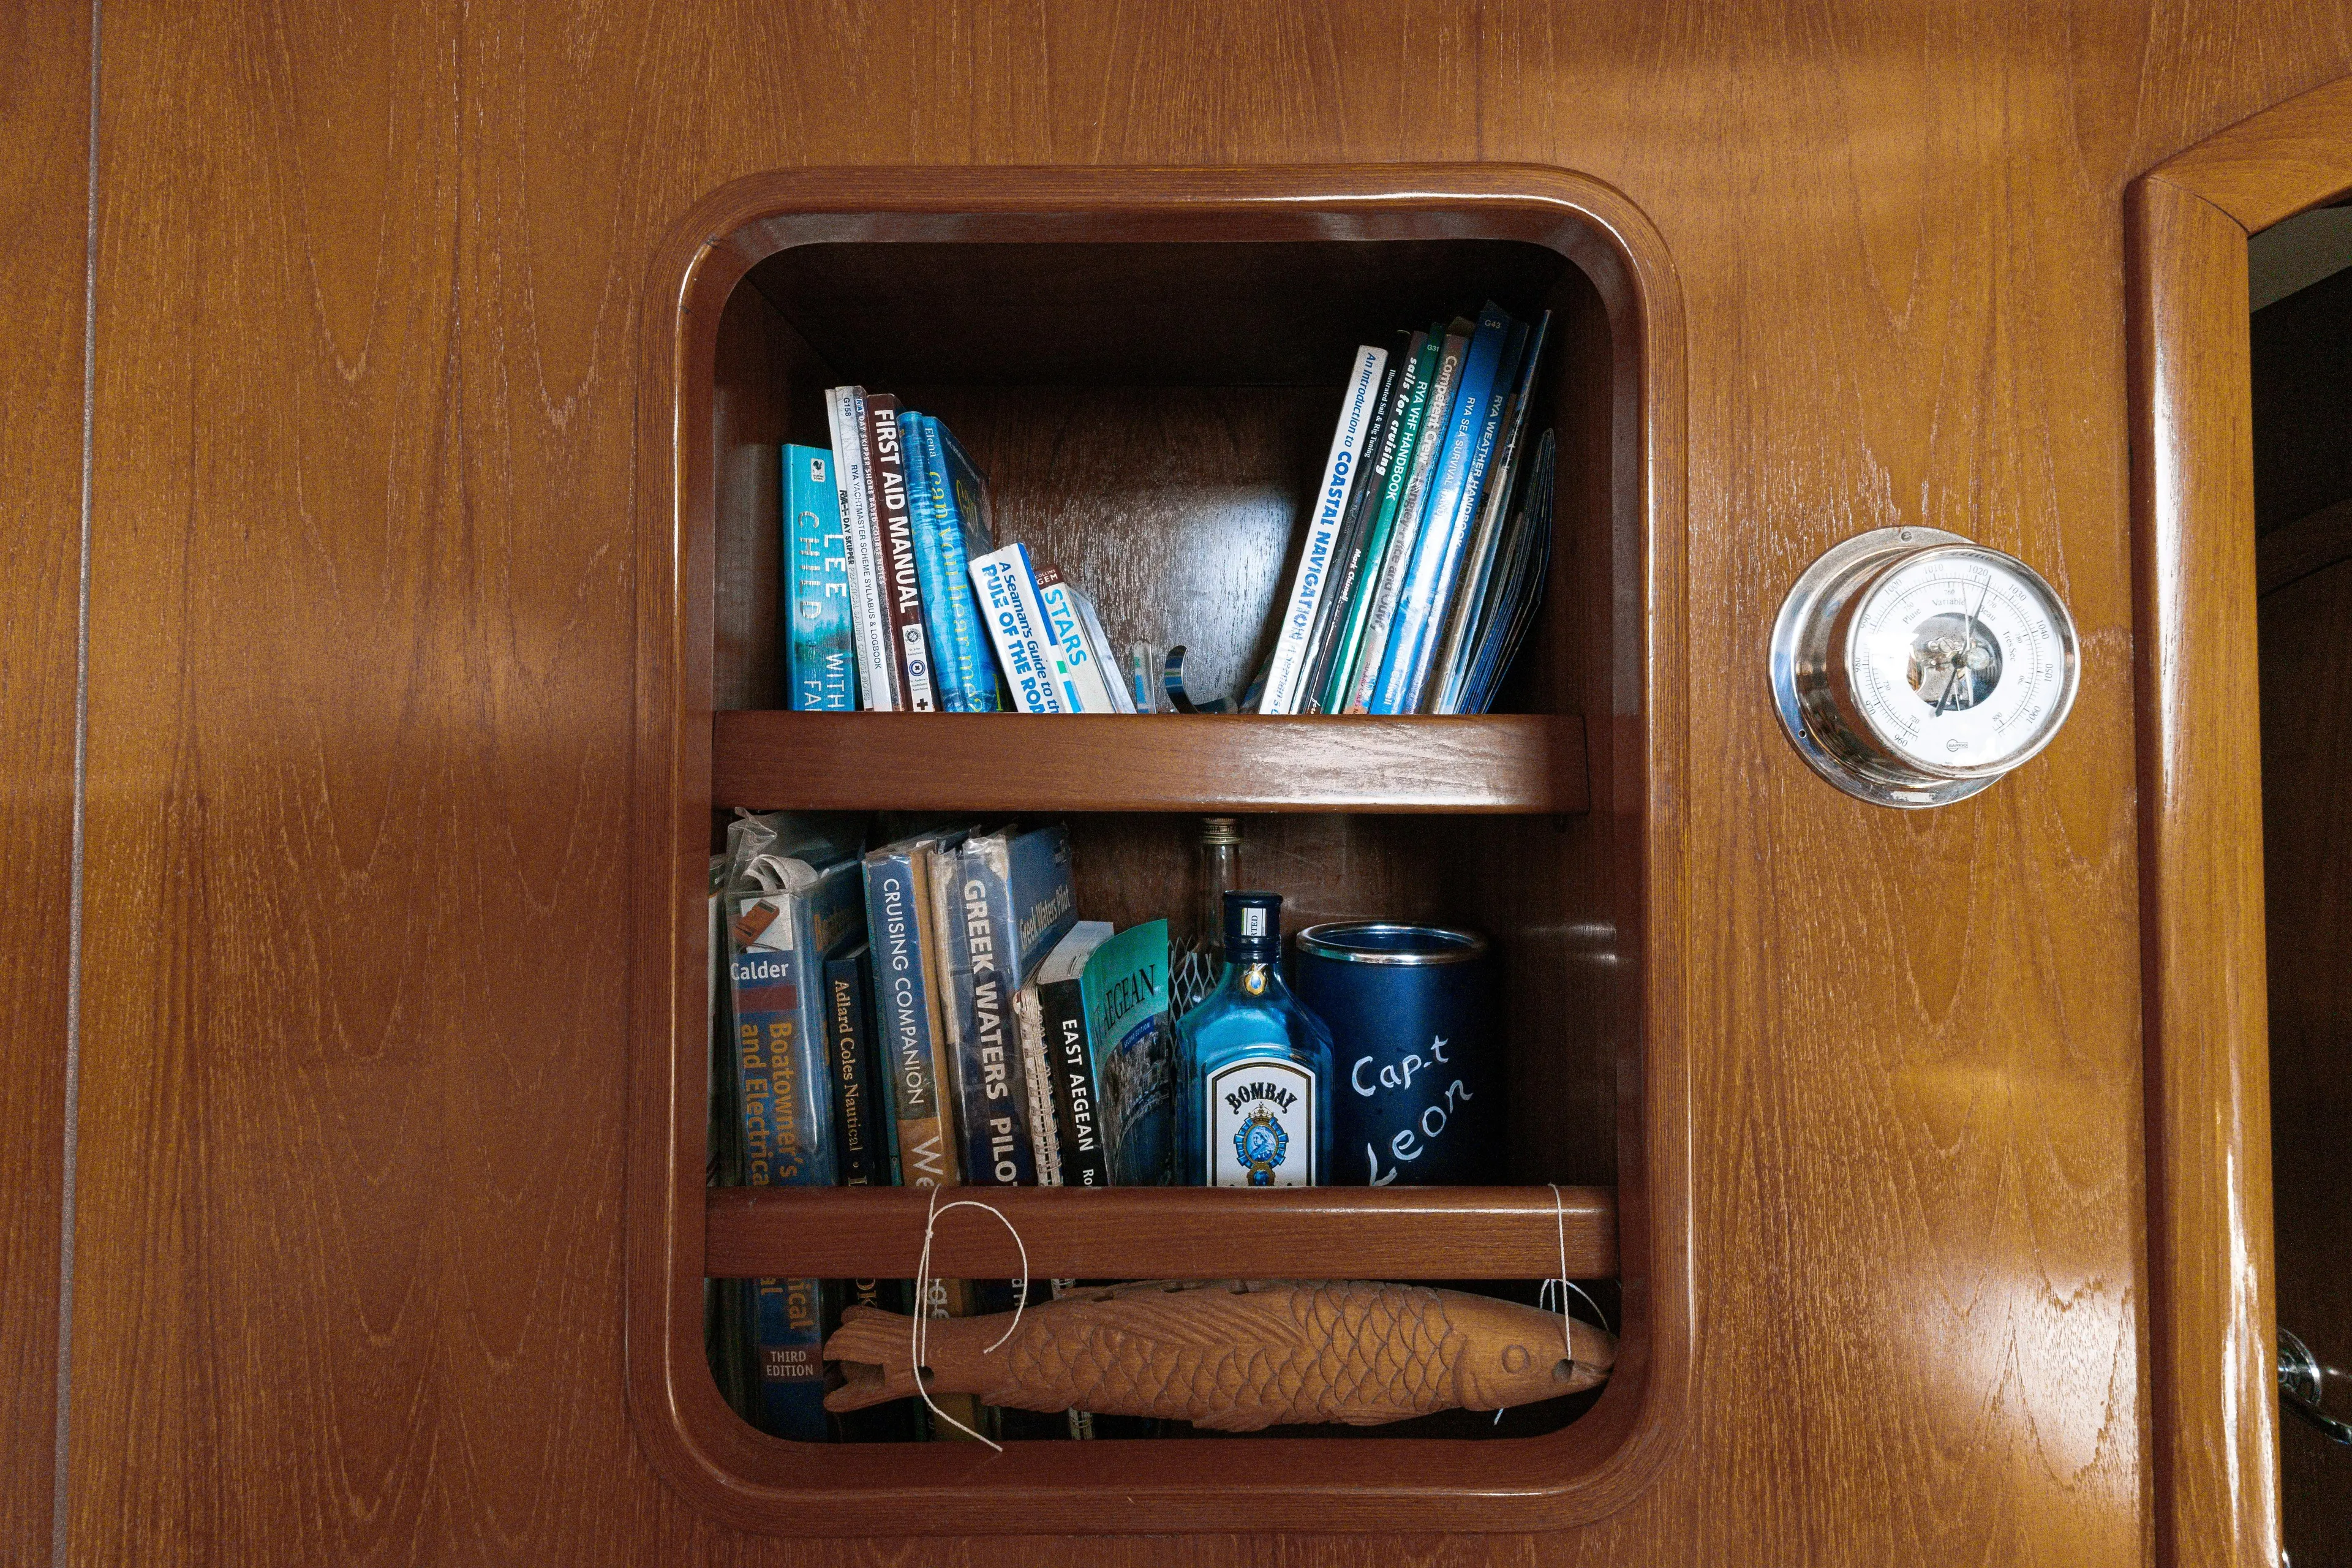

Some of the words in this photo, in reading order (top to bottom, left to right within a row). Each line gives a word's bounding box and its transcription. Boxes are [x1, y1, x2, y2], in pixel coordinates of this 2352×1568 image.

[1484, 318, 1501, 329] G43
[1365, 352, 1376, 368] An
[1427, 344, 1440, 353] G31
[1379, 368, 1396, 402] Illustrated
[1402, 356, 1417, 390] sails
[1348, 369, 1373, 434] Introduction
[1395, 393, 1410, 417] for
[1414, 380, 1428, 404] RYA
[1428, 355, 1458, 432] Competent
[1463, 396, 1476, 417] RYA
[1489, 394, 1504, 418] RYA
[843, 397, 852, 417] G158
[1377, 401, 1387, 415] Sail
[1406, 407, 1421, 431] VHF
[858, 416, 867, 432] DAY
[874, 409, 900, 464] FIRST
[1370, 422, 1381, 435] Rig
[1457, 418, 1470, 438] SEA
[861, 434, 872, 467] SKIPPER
[924, 428, 937, 458] Elena
[1344, 434, 1355, 448] to
[1363, 435, 1378, 458] Tuning
[1375, 419, 1400, 477] cruising
[1417, 429, 1437, 466] Crew
[1472, 421, 1496, 478] WEATHER
[851, 464, 859, 481] RYA
[1385, 431, 1414, 502] HANDBOOK
[1444, 437, 1464, 486] SURVIVAL
[864, 469, 874, 496] SHORE
[882, 472, 905, 510] AID
[929, 472, 949, 519] can
[1320, 451, 1352, 526] COASTAL
[853, 481, 866, 541] YACHTMASTER
[869, 497, 878, 522] BASED
[1457, 480, 1479, 549] HANDBOOK
[843, 518, 851, 533] DAY
[872, 524, 881, 556] COURSE
[798, 511, 823, 619] CHILD
[845, 536, 855, 565] SKIPPER
[860, 543, 870, 577] SCHEME
[888, 516, 919, 614] MANUAL
[1349, 548, 1362, 569] Mark
[824, 534, 847, 598] LEE
[876, 558, 885, 585] NOTES
[998, 561, 1012, 573] A
[1035, 568, 1056, 579] COLLINS
[1037, 573, 1058, 586] GEM
[1924, 564, 1943, 575] 1010
[1969, 565, 1989, 577] 1020
[864, 578, 876, 620] SYLLABUS
[1341, 570, 1355, 602] Chisnell
[1884, 578, 1902, 595] 1000
[2008, 584, 2027, 601] 1030
[948, 584, 970, 647] hear
[1004, 574, 1033, 639] Seaman's
[1903, 601, 1914, 612] 750
[1932, 597, 1966, 606] Variable
[1979, 604, 1997, 622] Beau
[1986, 599, 1997, 609] 770
[999, 611, 1020, 636] OF
[1044, 588, 1087, 666] STARS
[1860, 614, 1871, 629] 990
[1902, 608, 1921, 625] Pluie
[2036, 619, 2050, 640] 1040
[870, 629, 882, 669] LOGBOOK
[2014, 632, 2022, 644] 780
[1008, 639, 1033, 675] THE
[1027, 640, 1047, 679] Guide
[826, 653, 845, 708] WITH
[958, 654, 984, 713] me?
[1883, 680, 1891, 691] 730
[2044, 663, 2054, 682] 1050
[1041, 681, 1054, 697] to
[1383, 670, 1400, 706] Colwell
[1865, 700, 1876, 715] 970
[1909, 714, 1920, 725] 720
[2026, 705, 2041, 724] 1060
[1894, 734, 1909, 747] 960
[883, 878, 908, 971] CRUISING
[964, 880, 995, 974] GREEK
[1019, 906, 1039, 952] Greek
[1036, 899, 1058, 933] Waters
[1055, 884, 1071, 916] Pilot
[730, 960, 790, 981] Calder
[835, 980, 854, 1034] Adlard
[1102, 963, 1155, 1036] AEGEAN
[741, 1023, 767, 1069] and
[894, 976, 925, 1104] COMPANION
[975, 980, 1008, 1100] WATERS
[1062, 1019, 1083, 1066] EAST
[1124, 1033, 1135, 1048] SECOND
[1135, 1022, 1150, 1036] EDITION
[839, 1037, 857, 1081] Coles
[769, 1022, 805, 1177] Boatowner's
[1069, 1074, 1094, 1152] AEGEAN
[1224, 1082, 1298, 1115] BOMBAY
[844, 1083, 864, 1152] Nautical
[1367, 1079, 1474, 1186] Leon
[990, 1117, 1018, 1187] PILO
[1082, 1168, 1094, 1187] Ro
[766, 1364, 814, 1378] EDITION
[770, 1350, 807, 1363] THIRD
